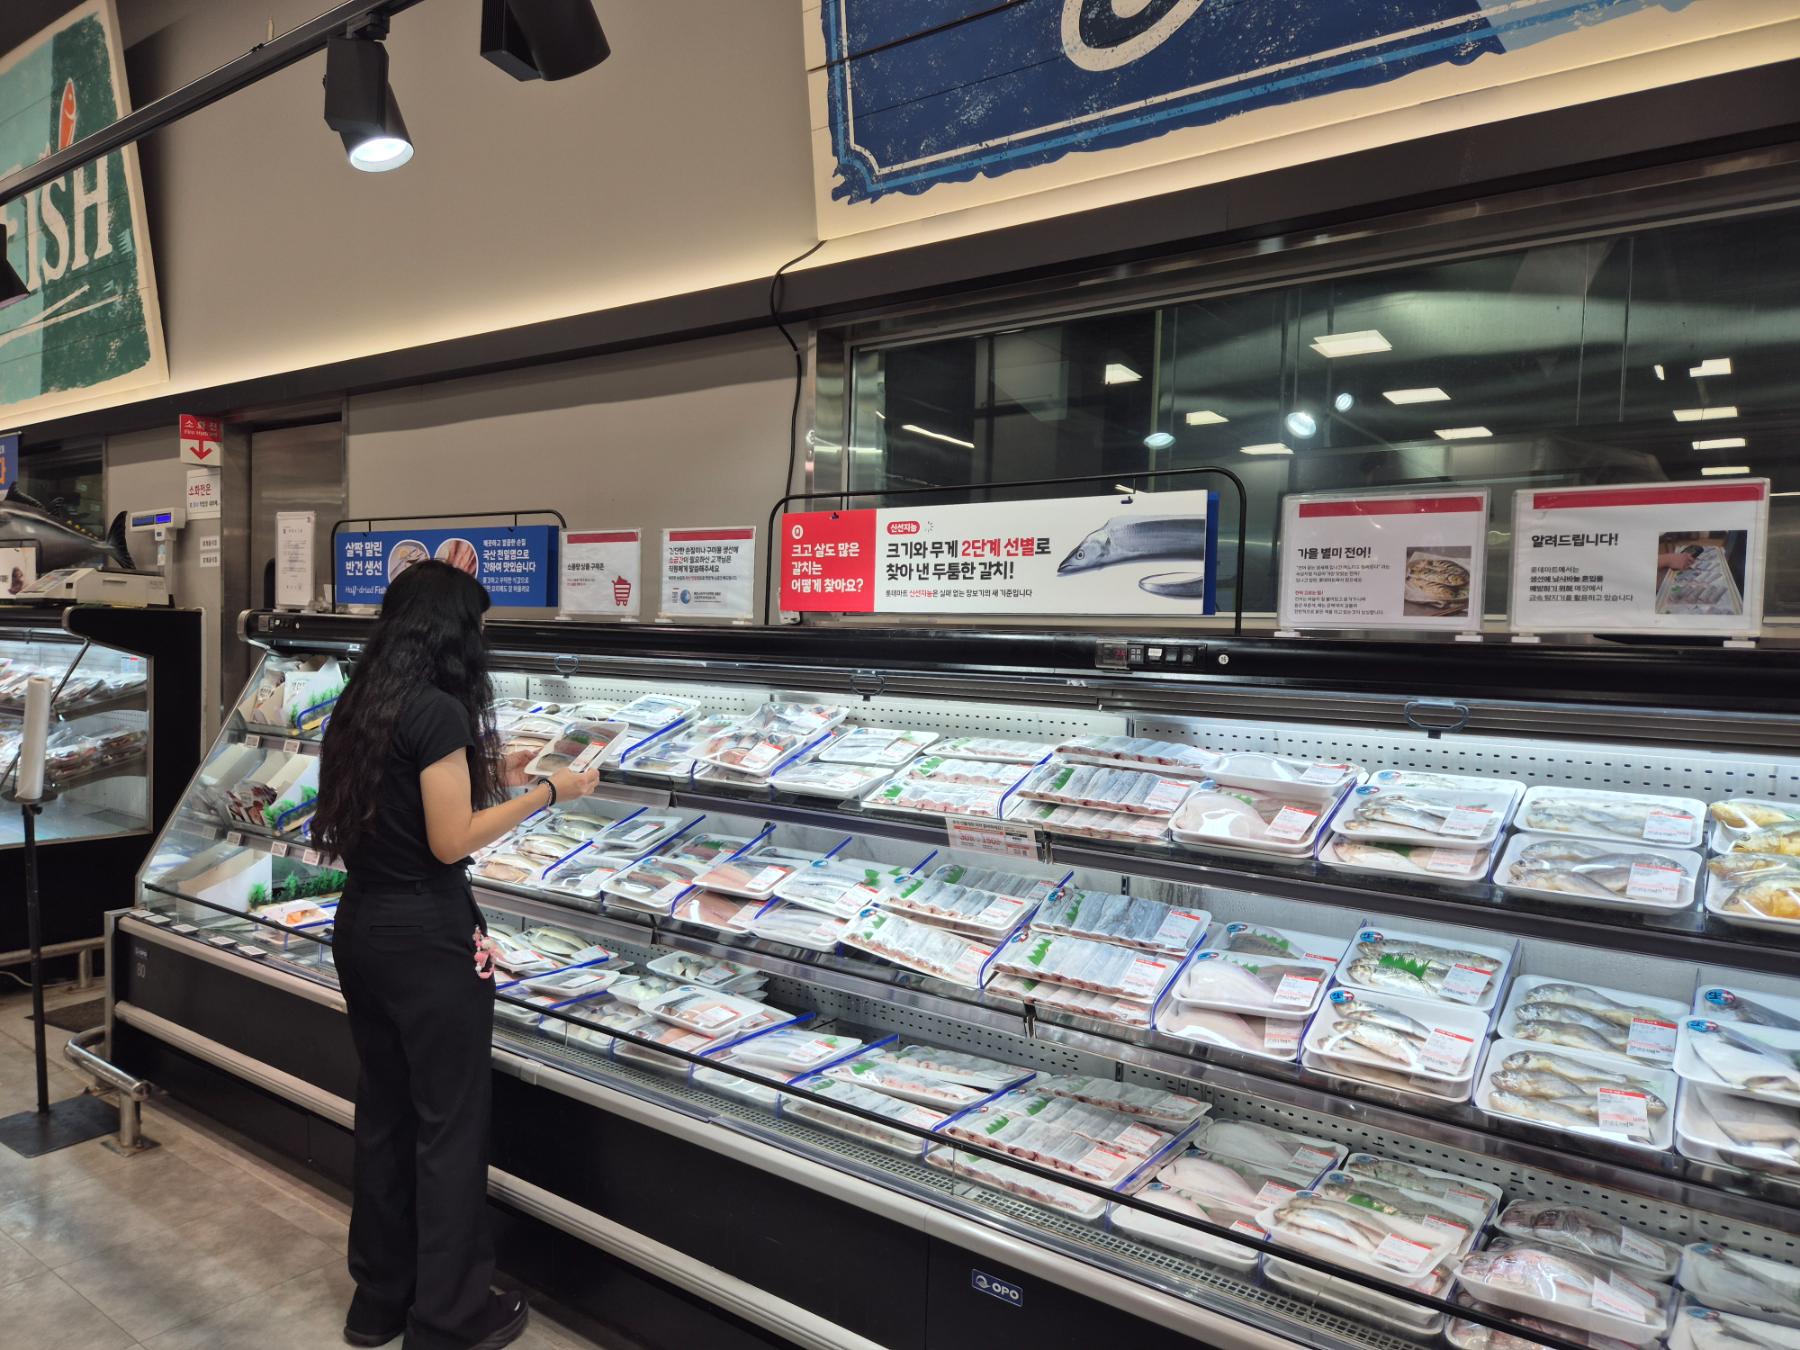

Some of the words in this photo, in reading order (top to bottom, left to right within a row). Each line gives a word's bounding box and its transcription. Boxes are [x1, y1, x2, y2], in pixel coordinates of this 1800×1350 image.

[189, 483, 211, 497] 소화전은
[890, 523, 918, 533] 신선지능
[1531, 533, 1619, 547] 알려드립니다!
[345, 541, 362, 557] 살짝
[365, 541, 382, 556] 말린
[483, 550, 496, 560] 국산
[497, 549, 530, 560] 천일염으로
[669, 547, 684, 555] 간단한
[792, 545, 812, 557] 크고
[814, 543, 835, 558] 살도
[839, 542, 860, 557] 많은
[886, 541, 927, 559] 크기와
[930, 540, 958, 559] 무게
[961, 538, 1001, 558] 2단계
[1004, 537, 1051, 557] 선별로
[1298, 548, 1319, 559] 가을
[1321, 547, 1342, 559] 별미
[1344, 546, 1371, 559] 전어!
[483, 561, 502, 573] 간하여
[503, 561, 536, 573] 맛있습니다
[668, 556, 688, 564] 소금간이
[690, 556, 710, 564] 필요하신
[346, 562, 363, 576] 반건
[365, 560, 382, 576] 생선
[668, 565, 688, 573] 직원에게
[689, 565, 720, 573] 말씀해주세요
[792, 561, 822, 575] 갈치는
[886, 562, 913, 581] 찾아
[916, 562, 930, 580] 낸
[932, 562, 976, 580] 두툼한
[980, 561, 1015, 579] 갈치!
[345, 586, 374, 597] Half-dried
[791, 578, 822, 593] 어떻게
[824, 578, 864, 593] 찾아요?
[939, 589, 952, 597] 실패
[953, 589, 966, 597] 없는
[966, 589, 990, 597] 장보기의
[992, 589, 998, 597] 새
[1000, 589, 1033, 597] 기준입니다
[992, 1282, 1020, 1300] OPO
